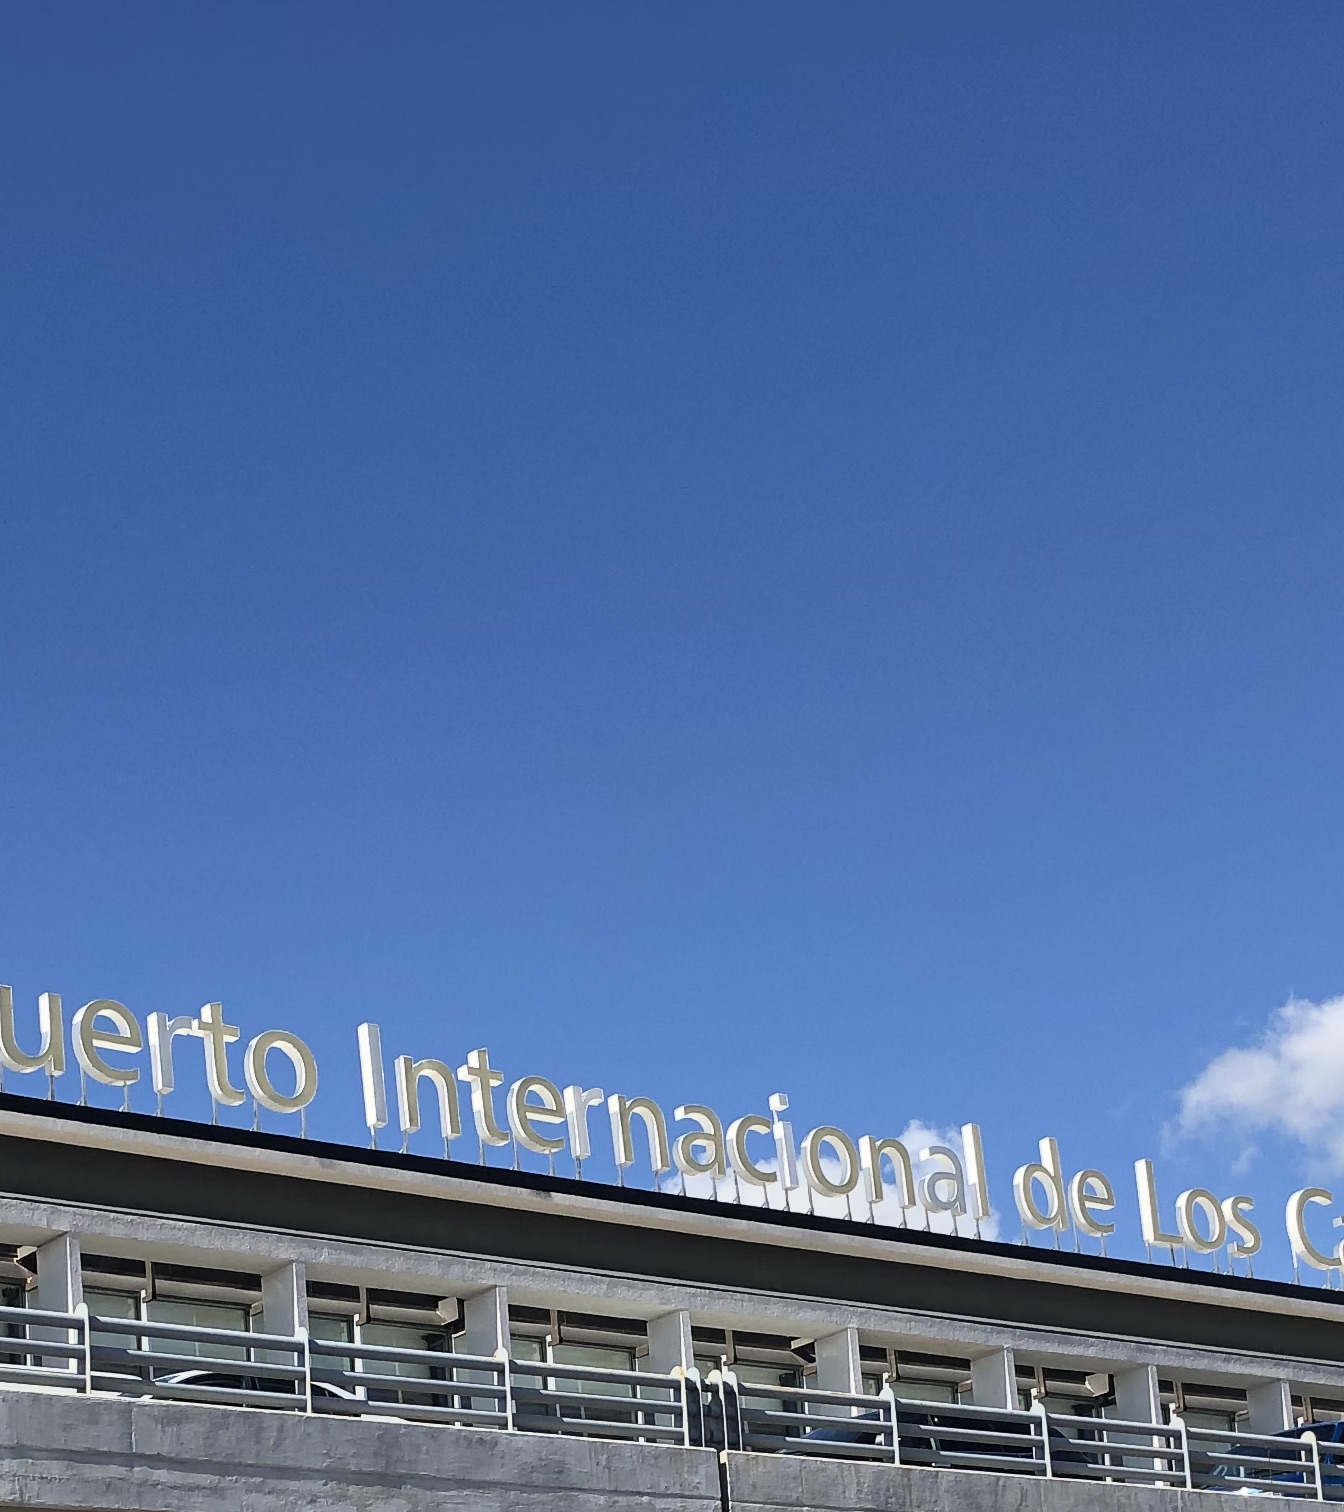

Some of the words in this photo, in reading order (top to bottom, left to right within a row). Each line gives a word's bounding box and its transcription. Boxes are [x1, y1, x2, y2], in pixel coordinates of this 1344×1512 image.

[357, 1022, 990, 1220] Internacional
[1013, 1137, 1115, 1236] de
[1134, 1158, 1261, 1258] Los
